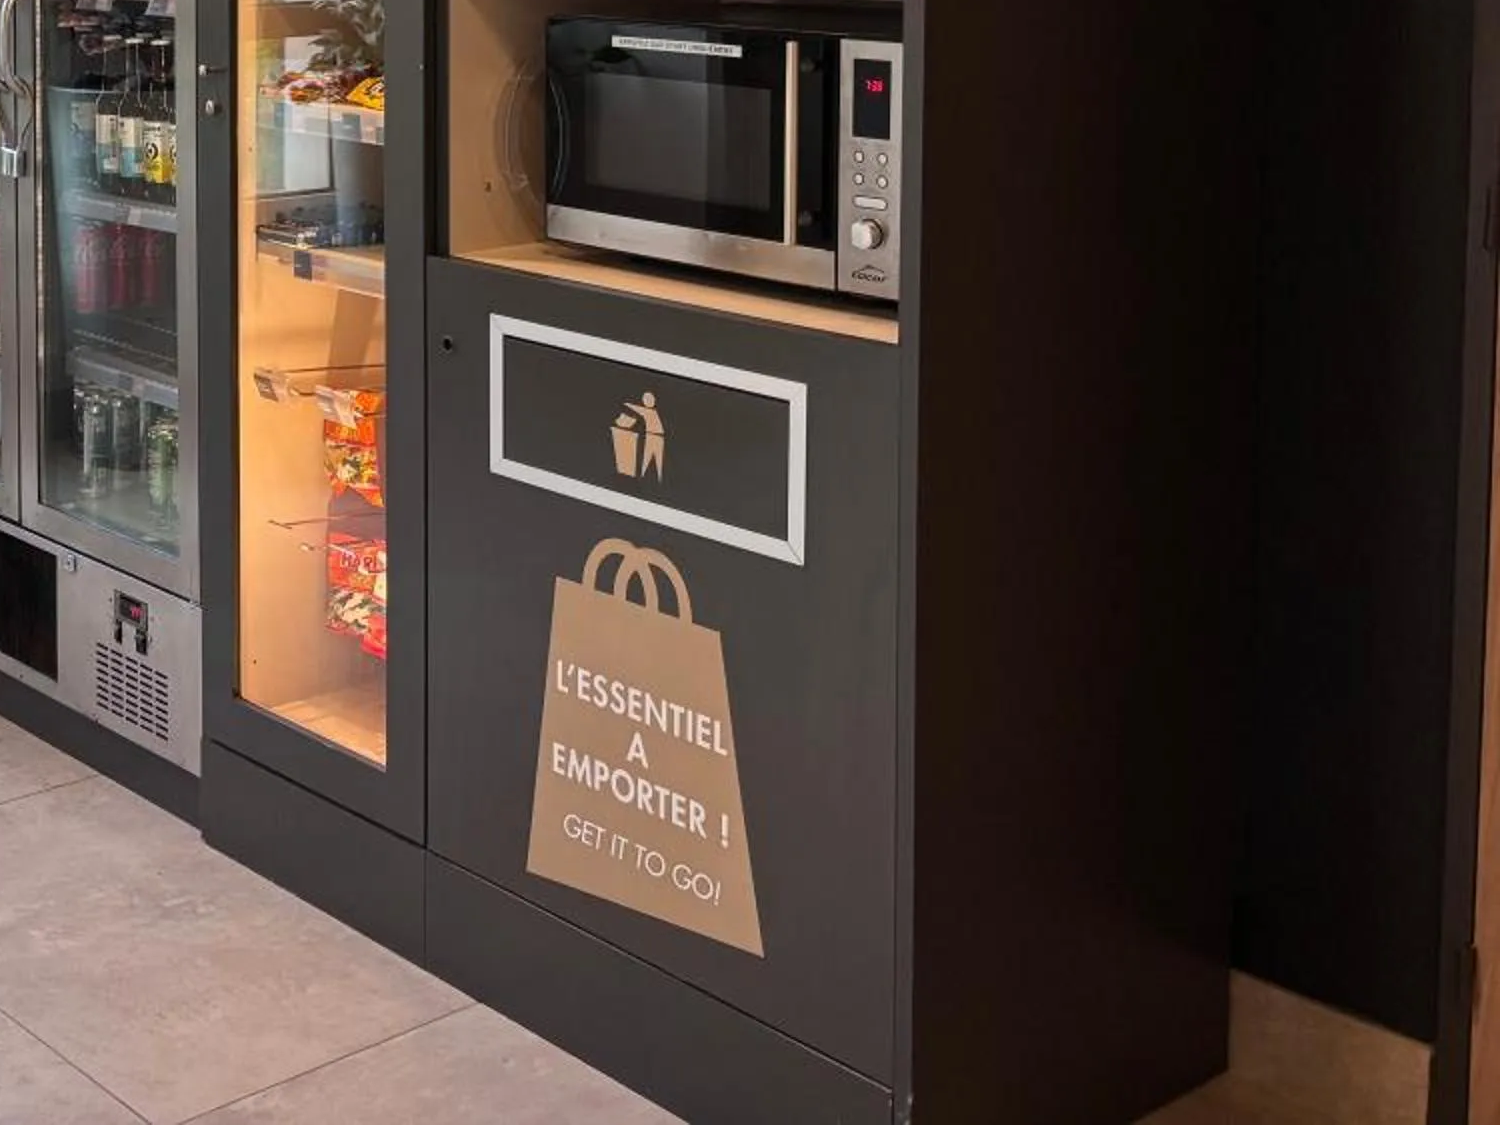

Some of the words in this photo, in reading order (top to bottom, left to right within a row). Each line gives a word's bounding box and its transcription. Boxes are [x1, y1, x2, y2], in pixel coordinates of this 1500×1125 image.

[556, 659, 729, 756] L'ESSENTIEL
[626, 731, 649, 768] A
[552, 741, 708, 839] EMPORTER
[563, 814, 606, 849] GET
[610, 833, 628, 861] IT
[635, 842, 666, 877] TO
[671, 865, 721, 906] GO!
